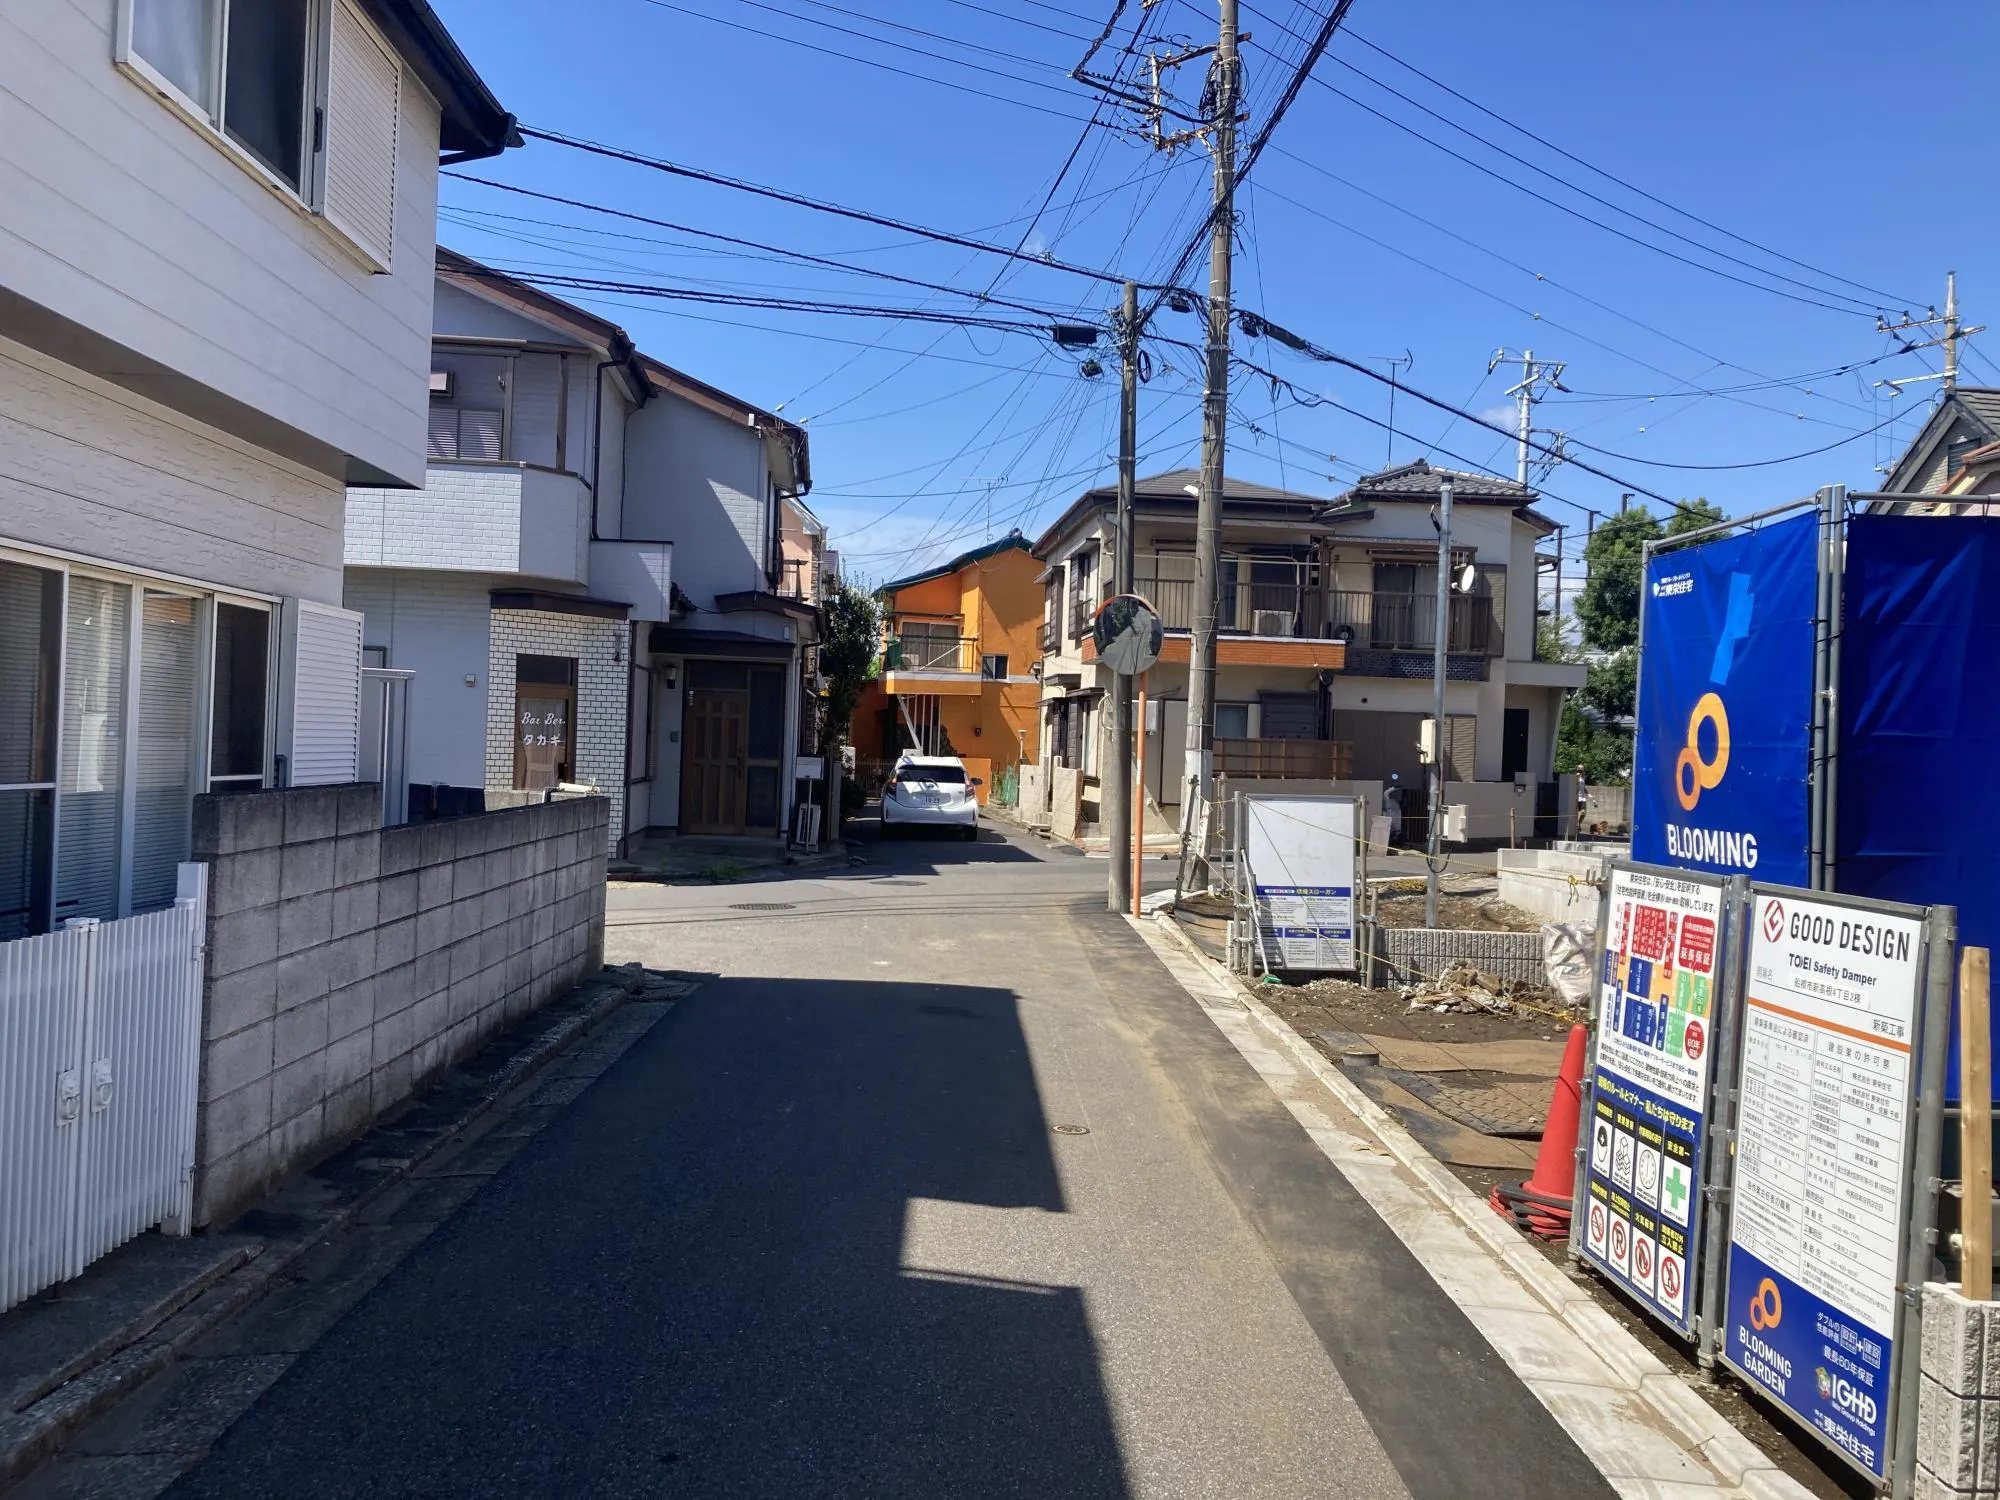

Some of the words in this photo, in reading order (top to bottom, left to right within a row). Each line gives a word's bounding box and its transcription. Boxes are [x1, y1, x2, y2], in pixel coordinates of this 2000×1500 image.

[521, 711, 541, 724] Bar
[523, 732, 561, 747] タカギ
[1667, 823, 1758, 869] BLOOMING
[1790, 913, 1834, 944] GOOD
[1839, 922, 1910, 960] DESIGN
[1813, 961, 1839, 978] Safety
[1841, 969, 1877, 987] Damper
[1872, 1019, 1905, 1037] 新築工事
[1666, 1140, 1690, 1159] 安全第一
[1661, 1234, 1683, 1255] 立入禁止
[1817, 1311, 1840, 1331] ダブルの
[1739, 1325, 1792, 1379] BLOOMING
[1824, 1345, 1873, 1388] 最長60年保証
[1744, 1351, 1786, 1397] GARDEN
[1832, 1374, 1877, 1425] IGHD
[1823, 1415, 1875, 1468] 東栄住宅
